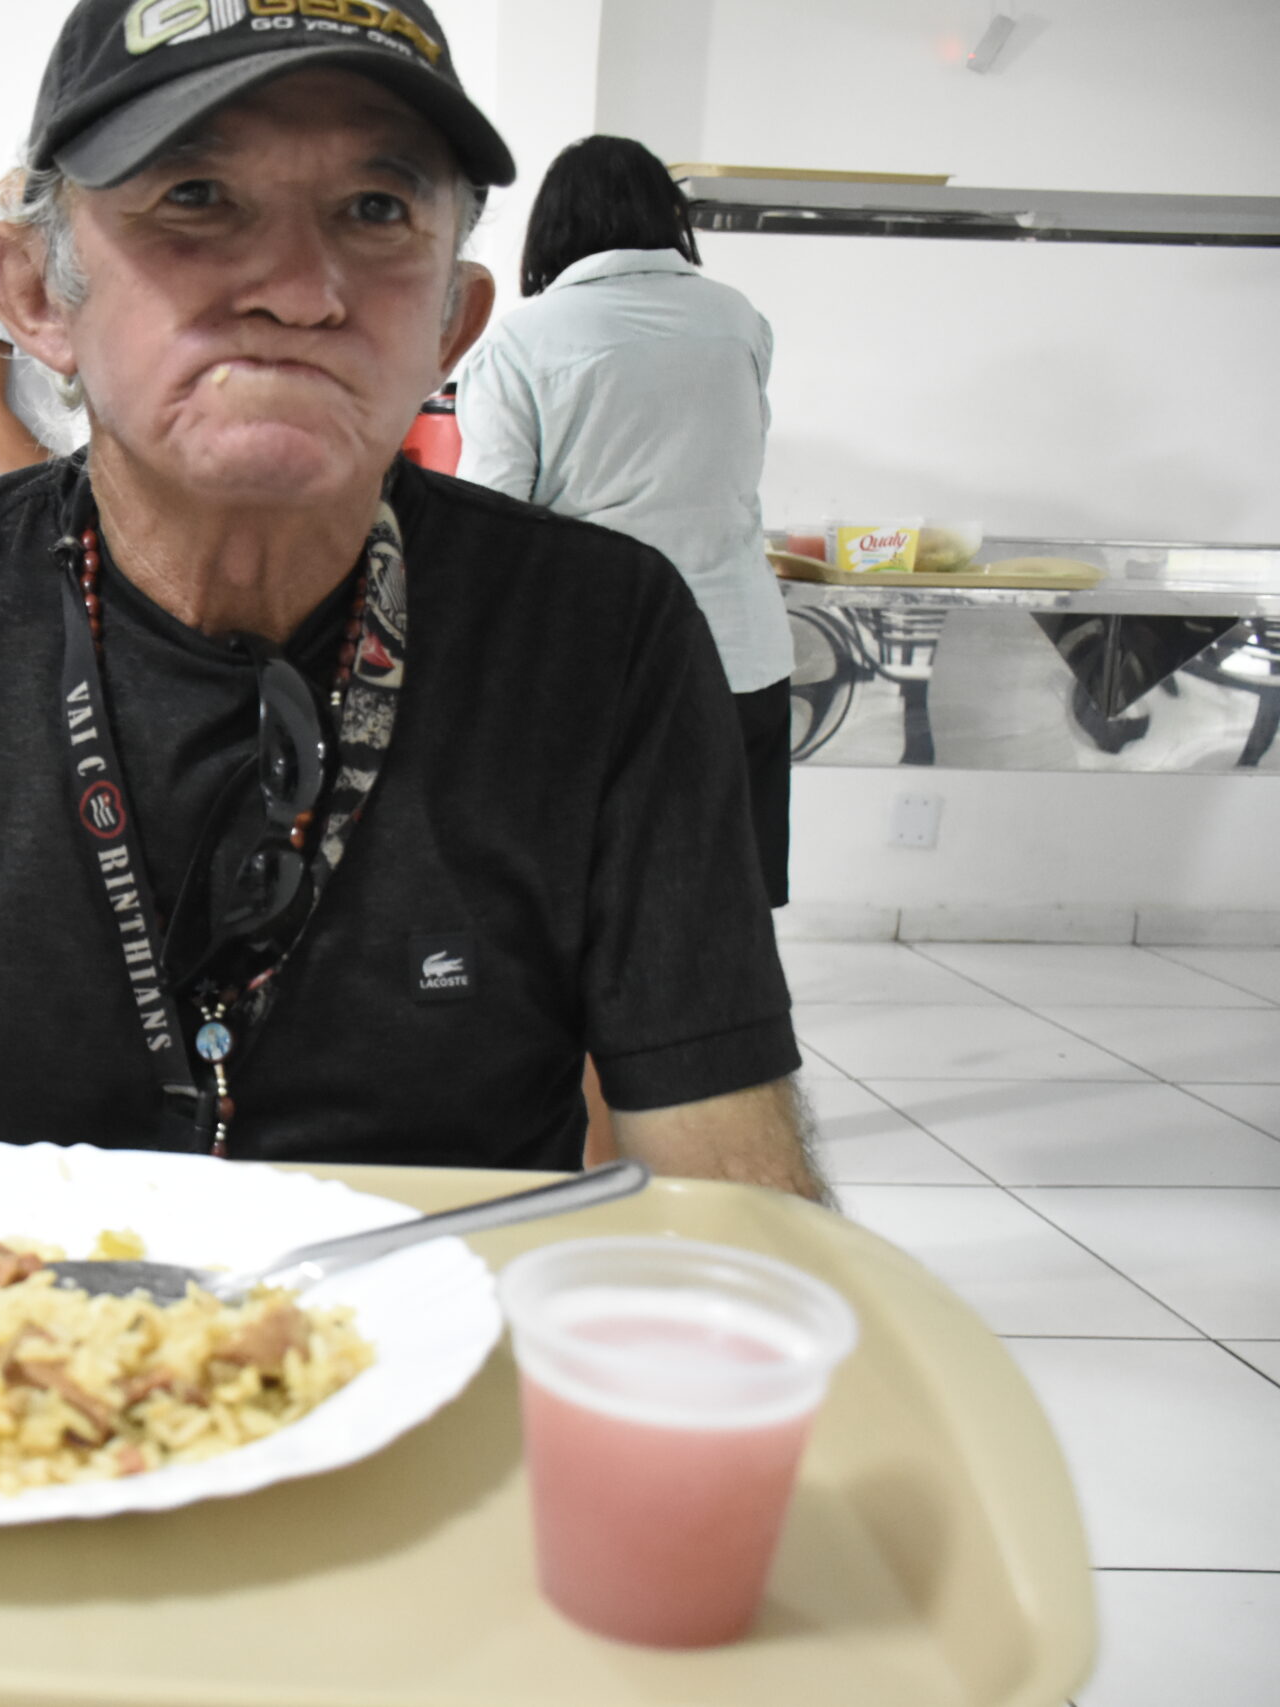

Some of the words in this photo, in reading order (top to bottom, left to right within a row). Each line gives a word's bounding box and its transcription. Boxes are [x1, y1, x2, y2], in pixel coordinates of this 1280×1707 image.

[858, 530, 908, 551] Qualy
[66, 680, 99, 746] VAI
[419, 975, 469, 989] LACOSTE
